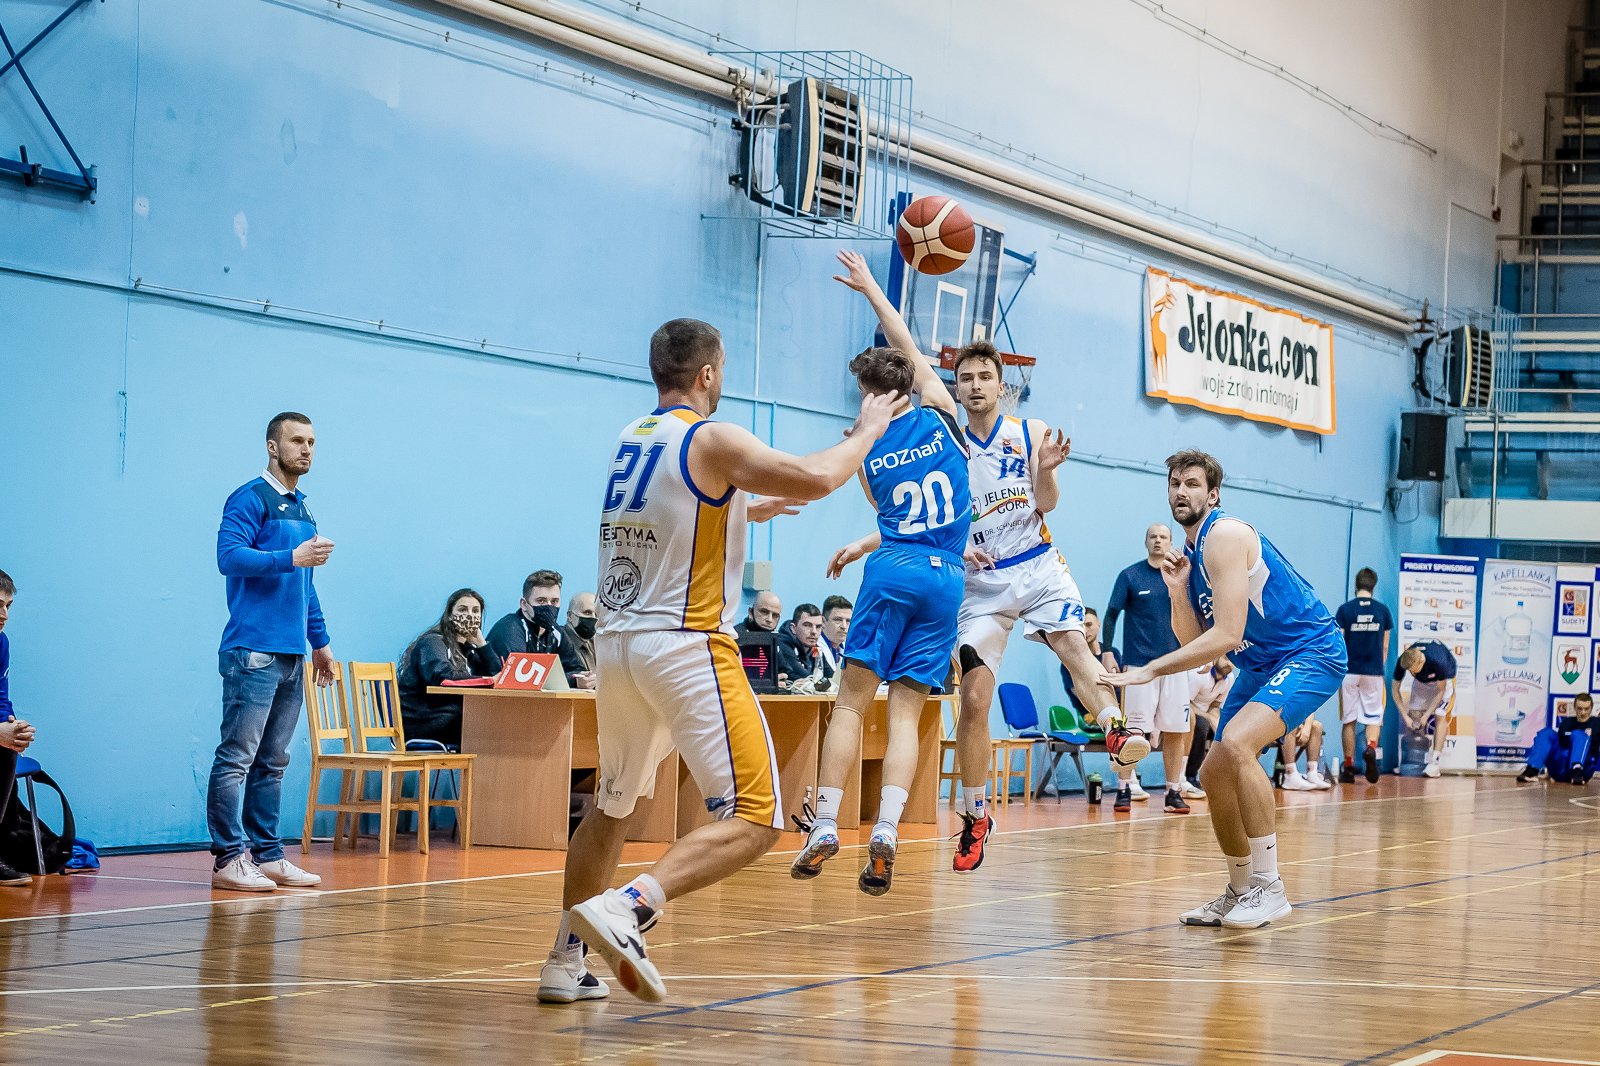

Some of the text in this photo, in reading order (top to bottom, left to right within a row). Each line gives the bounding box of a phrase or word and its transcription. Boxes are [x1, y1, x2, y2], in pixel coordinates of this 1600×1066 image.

[602, 441, 667, 513] 21
[997, 457, 1025, 480] 14
[892, 470, 955, 535] 20
[985, 487, 1027, 506] JELENIA
[997, 519, 1027, 531] SCHNEIDE
[605, 571, 635, 596] Mint
[1493, 568, 1551, 584] KAPELLANKA
[1059, 602, 1083, 622] 14
[515, 657, 546, 686] 5
[1486, 669, 1542, 684] KAPELLANKA
